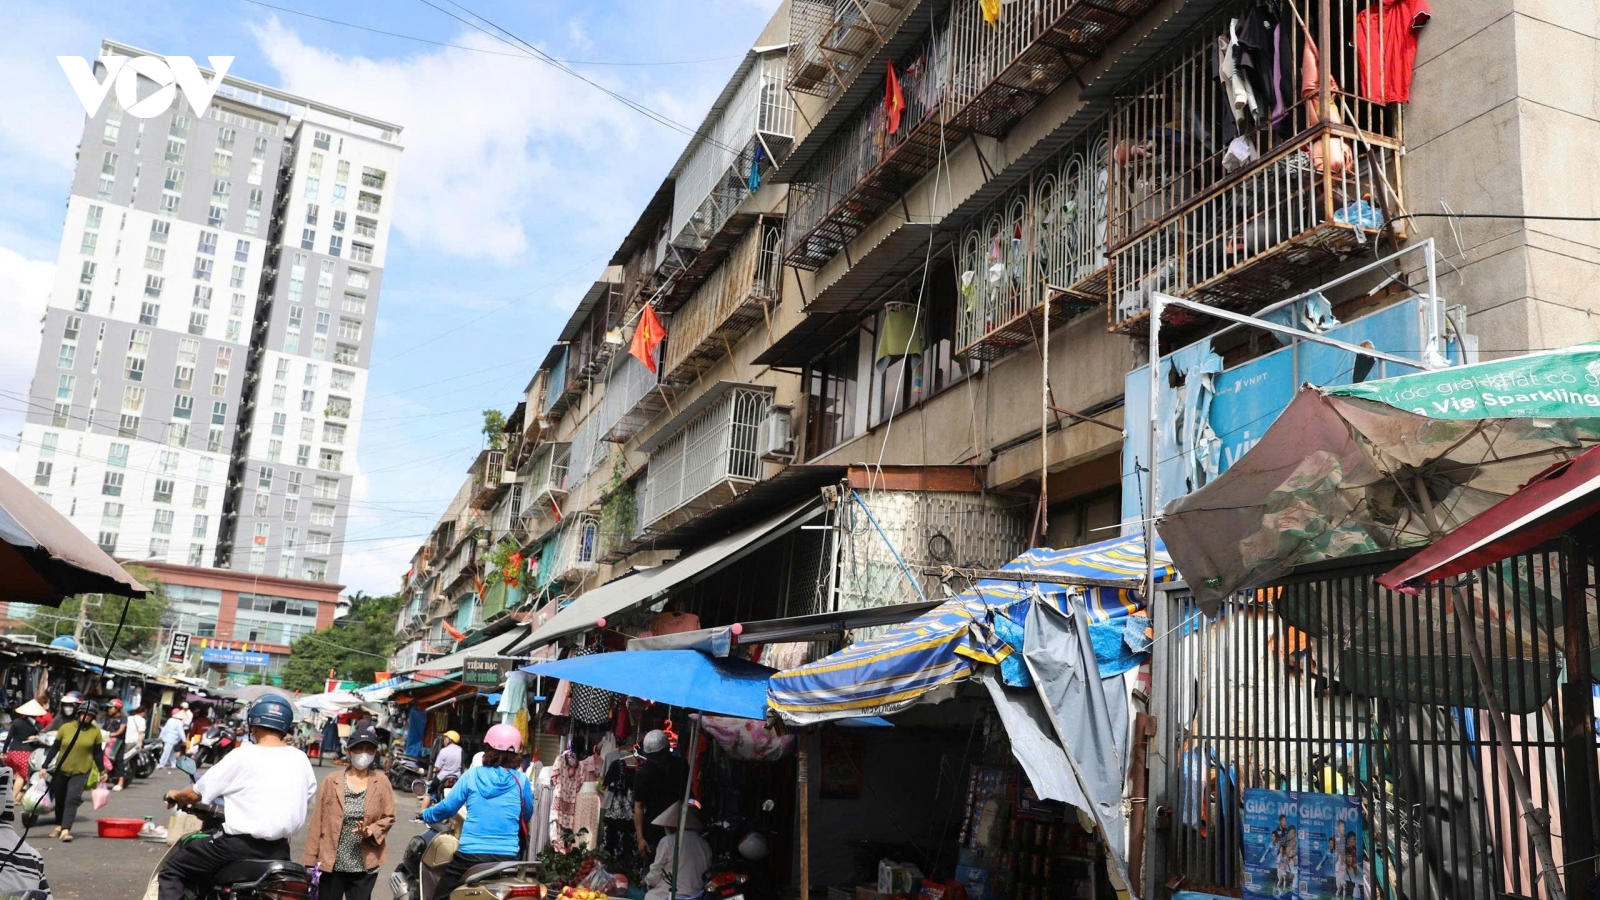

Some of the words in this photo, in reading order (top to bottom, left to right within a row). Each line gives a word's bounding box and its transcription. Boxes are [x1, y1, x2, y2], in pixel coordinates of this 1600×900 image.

[1243, 372, 1268, 387] VNPT
[1432, 397, 1475, 413] Vie
[1481, 389, 1600, 408] Sparkling
[1245, 796, 1275, 815] GIẤC
[1299, 801, 1332, 820] GIẤC
